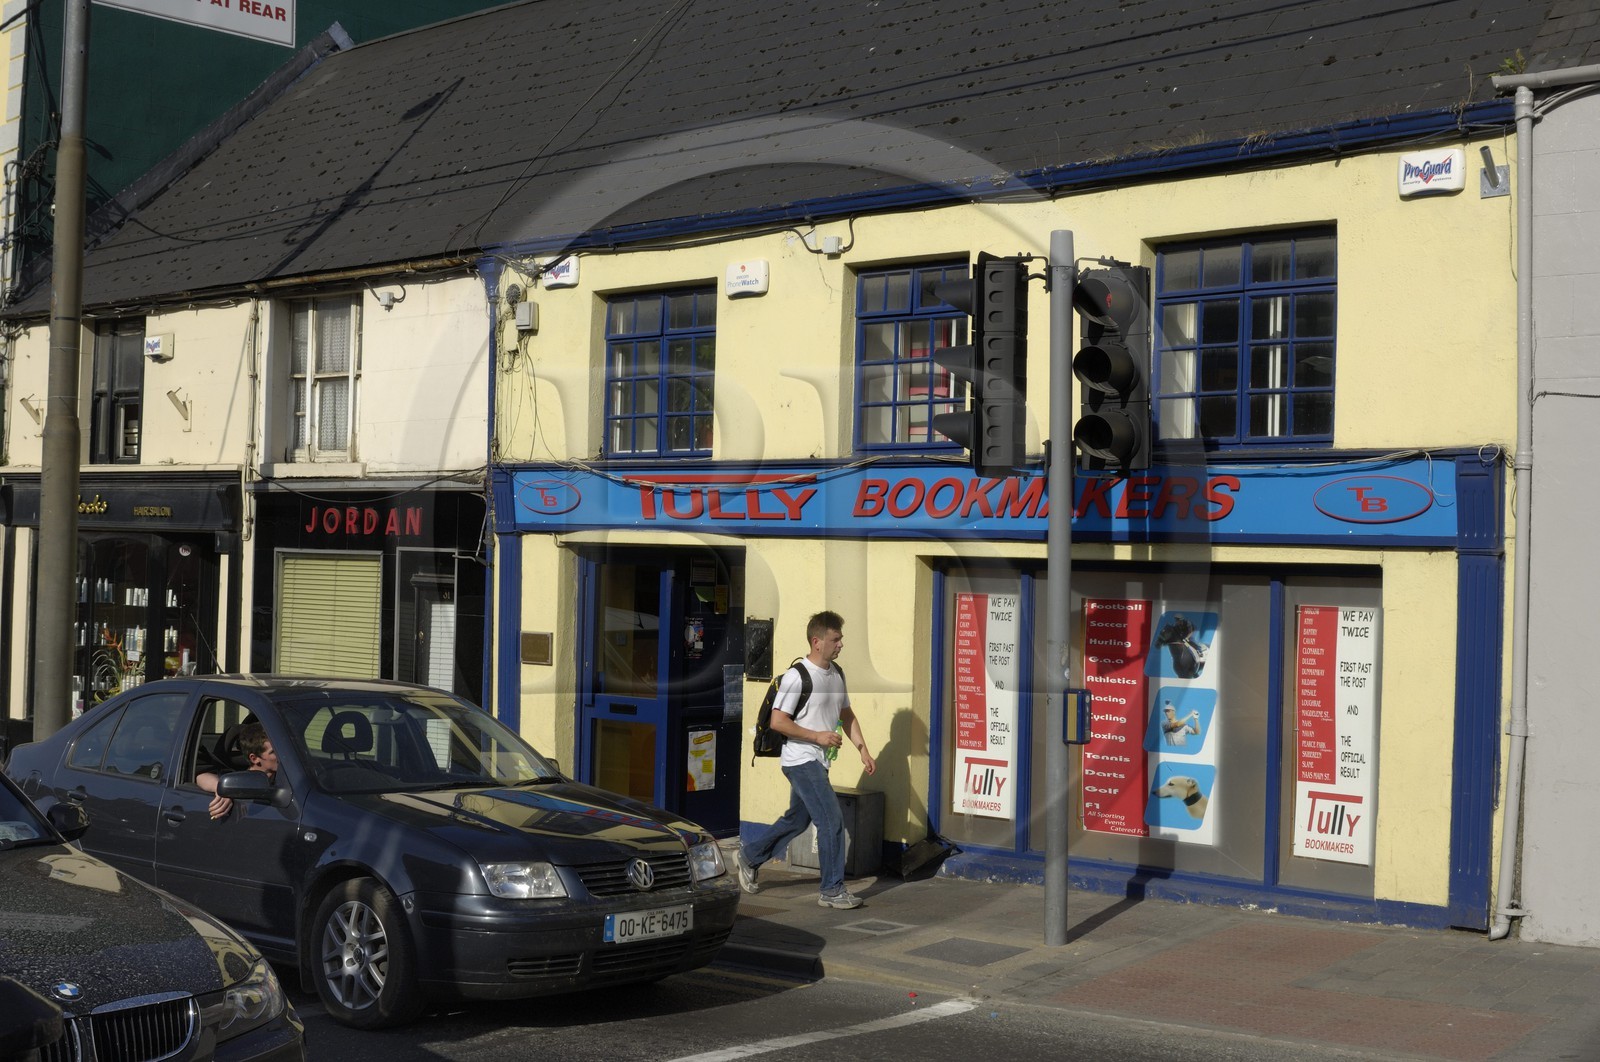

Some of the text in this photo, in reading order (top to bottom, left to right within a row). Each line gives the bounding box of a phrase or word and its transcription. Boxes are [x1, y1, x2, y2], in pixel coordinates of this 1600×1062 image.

[239, 0, 286, 21] REAR
[1403, 159, 1452, 182] Pro-Guard
[727, 278, 759, 288] PhoneWatch
[622, 474, 818, 520] TULLY
[305, 506, 422, 536] JORDAN
[992, 598, 1016, 608] WE PAY
[1090, 602, 1142, 611] Football
[990, 612, 1012, 622] TWICE
[1343, 610, 1374, 622] WE PAY
[1090, 620, 1128, 628] Soccer
[1342, 626, 1370, 638] TWICE
[988, 642, 1014, 653] FIRST PAST
[1089, 638, 1132, 648] Hurling
[989, 656, 1010, 666] THE POST
[1340, 662, 1372, 674] FIRST PAST
[994, 680, 1004, 690] AND
[1086, 676, 1137, 685] Athletics
[1340, 676, 1366, 688] THE POST
[990, 707, 999, 718] THE
[1347, 704, 1358, 716] AND
[1090, 712, 1127, 724] ycling
[990, 721, 1010, 732] OFFICIAL
[990, 734, 1006, 746] RESULT
[1341, 736, 1352, 746] THE
[1084, 752, 1131, 762] Tennis
[1340, 752, 1366, 764] OFFICIAL
[1084, 769, 1126, 778] Darts
[1340, 766, 1360, 778] RESULT
[1084, 786, 1119, 794] Golf
[962, 798, 1002, 812] BOOKMAKERS
[1098, 812, 1126, 820] Sporting
[1110, 825, 1138, 834] Catered
[1304, 838, 1354, 854] BOOKMAKERS
[620, 911, 688, 937] 00-KE-6475
